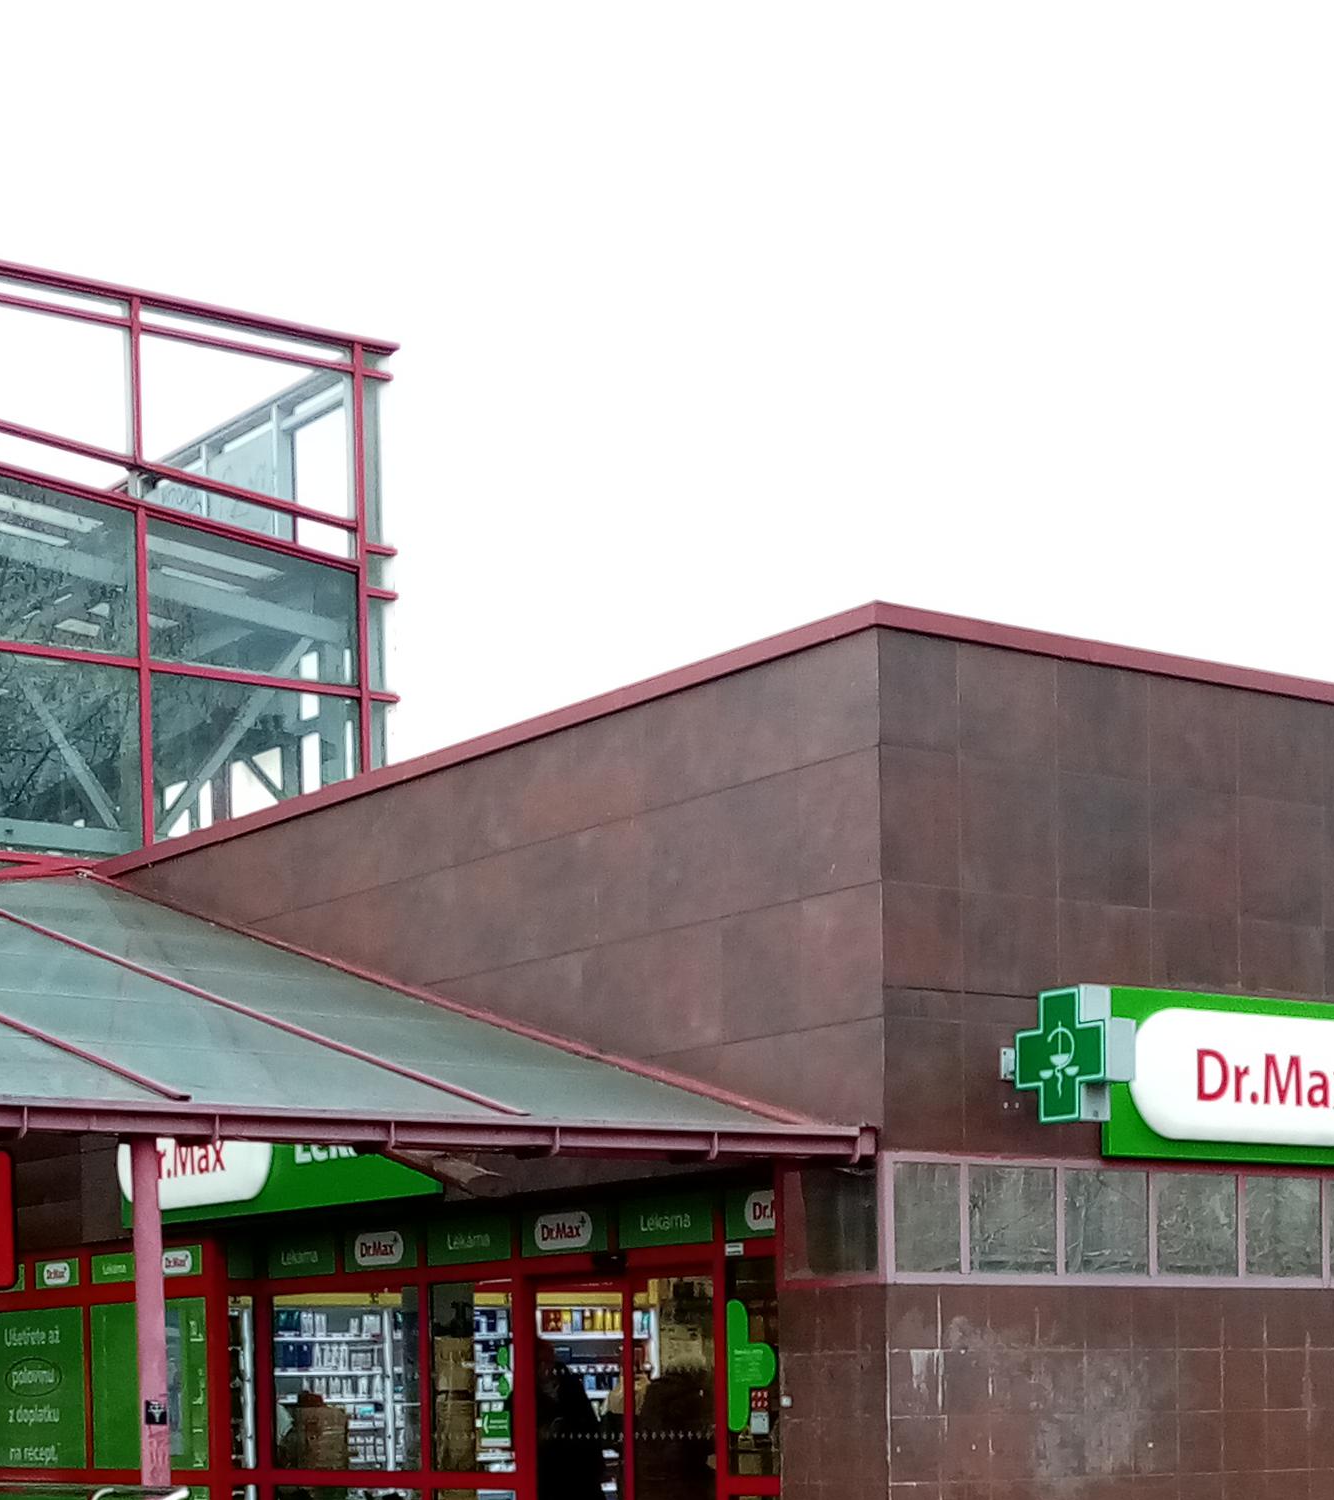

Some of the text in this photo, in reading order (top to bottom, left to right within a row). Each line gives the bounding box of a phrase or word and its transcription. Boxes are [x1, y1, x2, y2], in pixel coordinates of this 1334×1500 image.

[156, 1140, 227, 1179] r.Max
[541, 1222, 581, 1241] Dr.Max
[360, 1242, 395, 1258] Dr.Max
